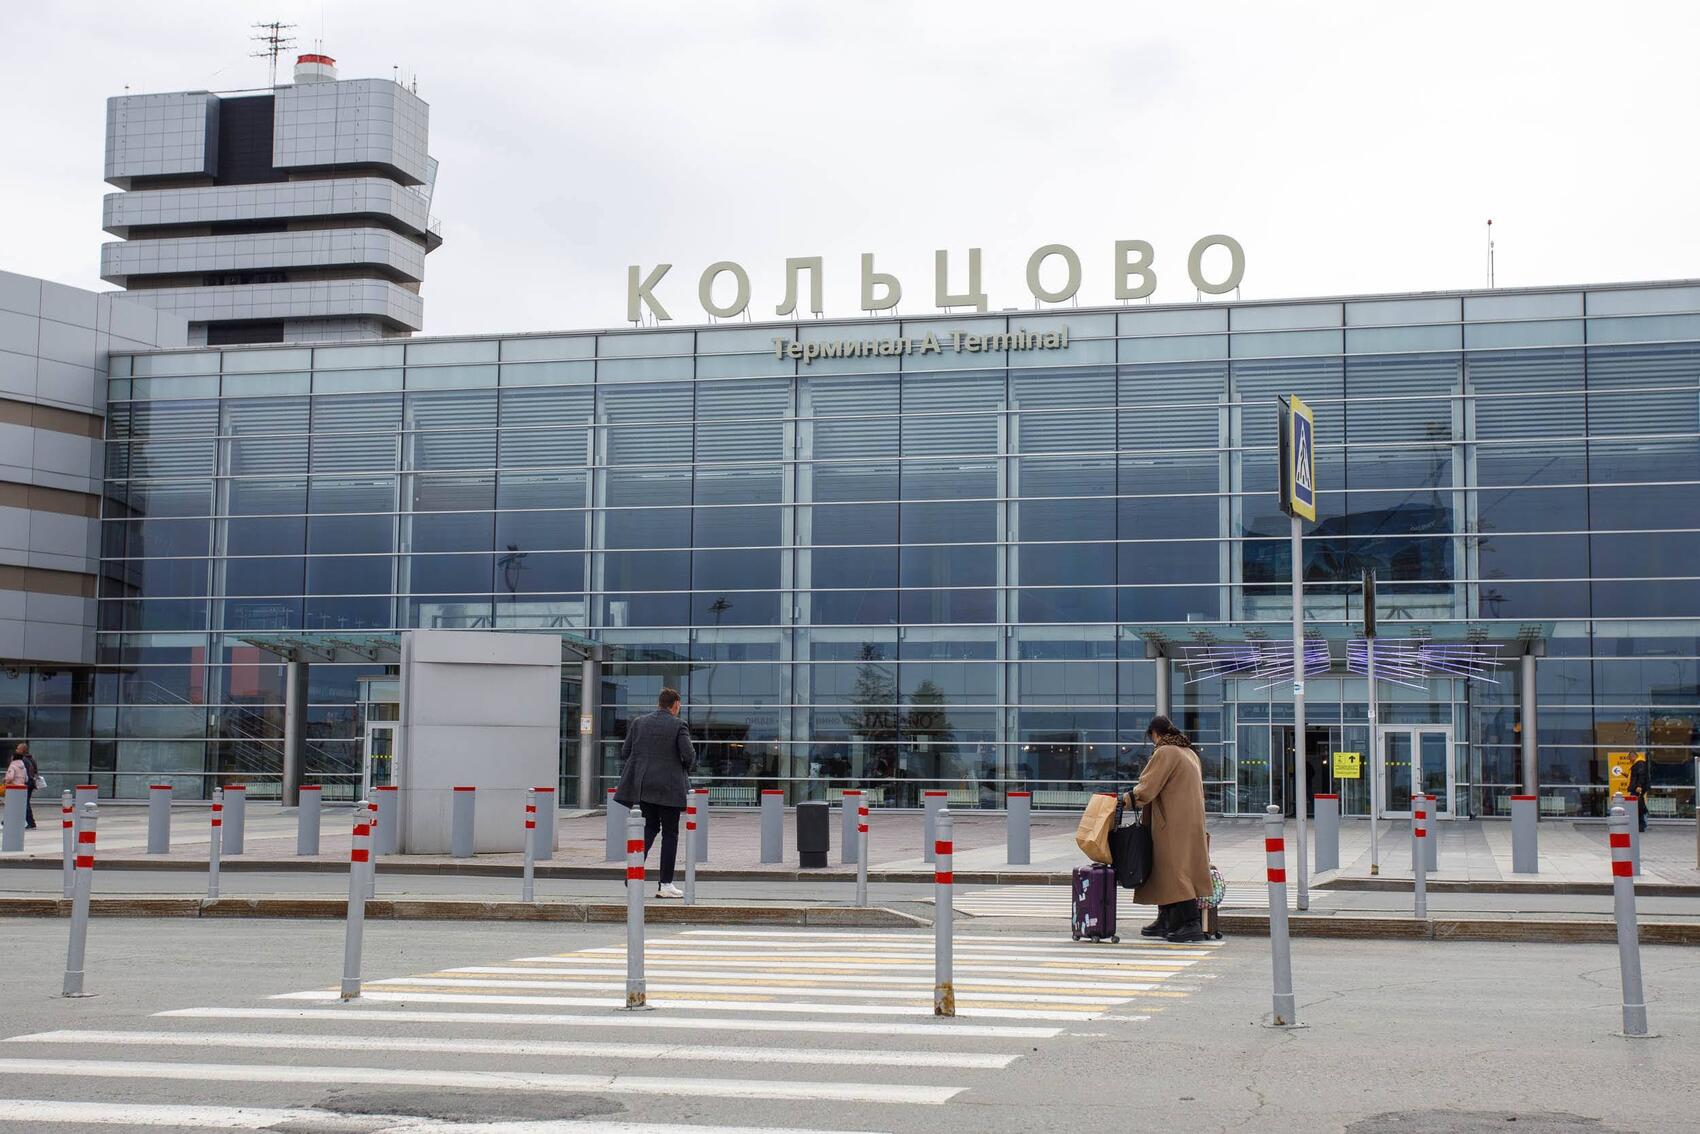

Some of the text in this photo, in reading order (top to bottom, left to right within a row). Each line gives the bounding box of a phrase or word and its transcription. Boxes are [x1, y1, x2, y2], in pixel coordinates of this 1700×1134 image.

[627, 233, 1246, 322] КОЛЬЦОВО
[773, 335, 912, 363] Терминал
[952, 324, 1068, 352] Terminal
